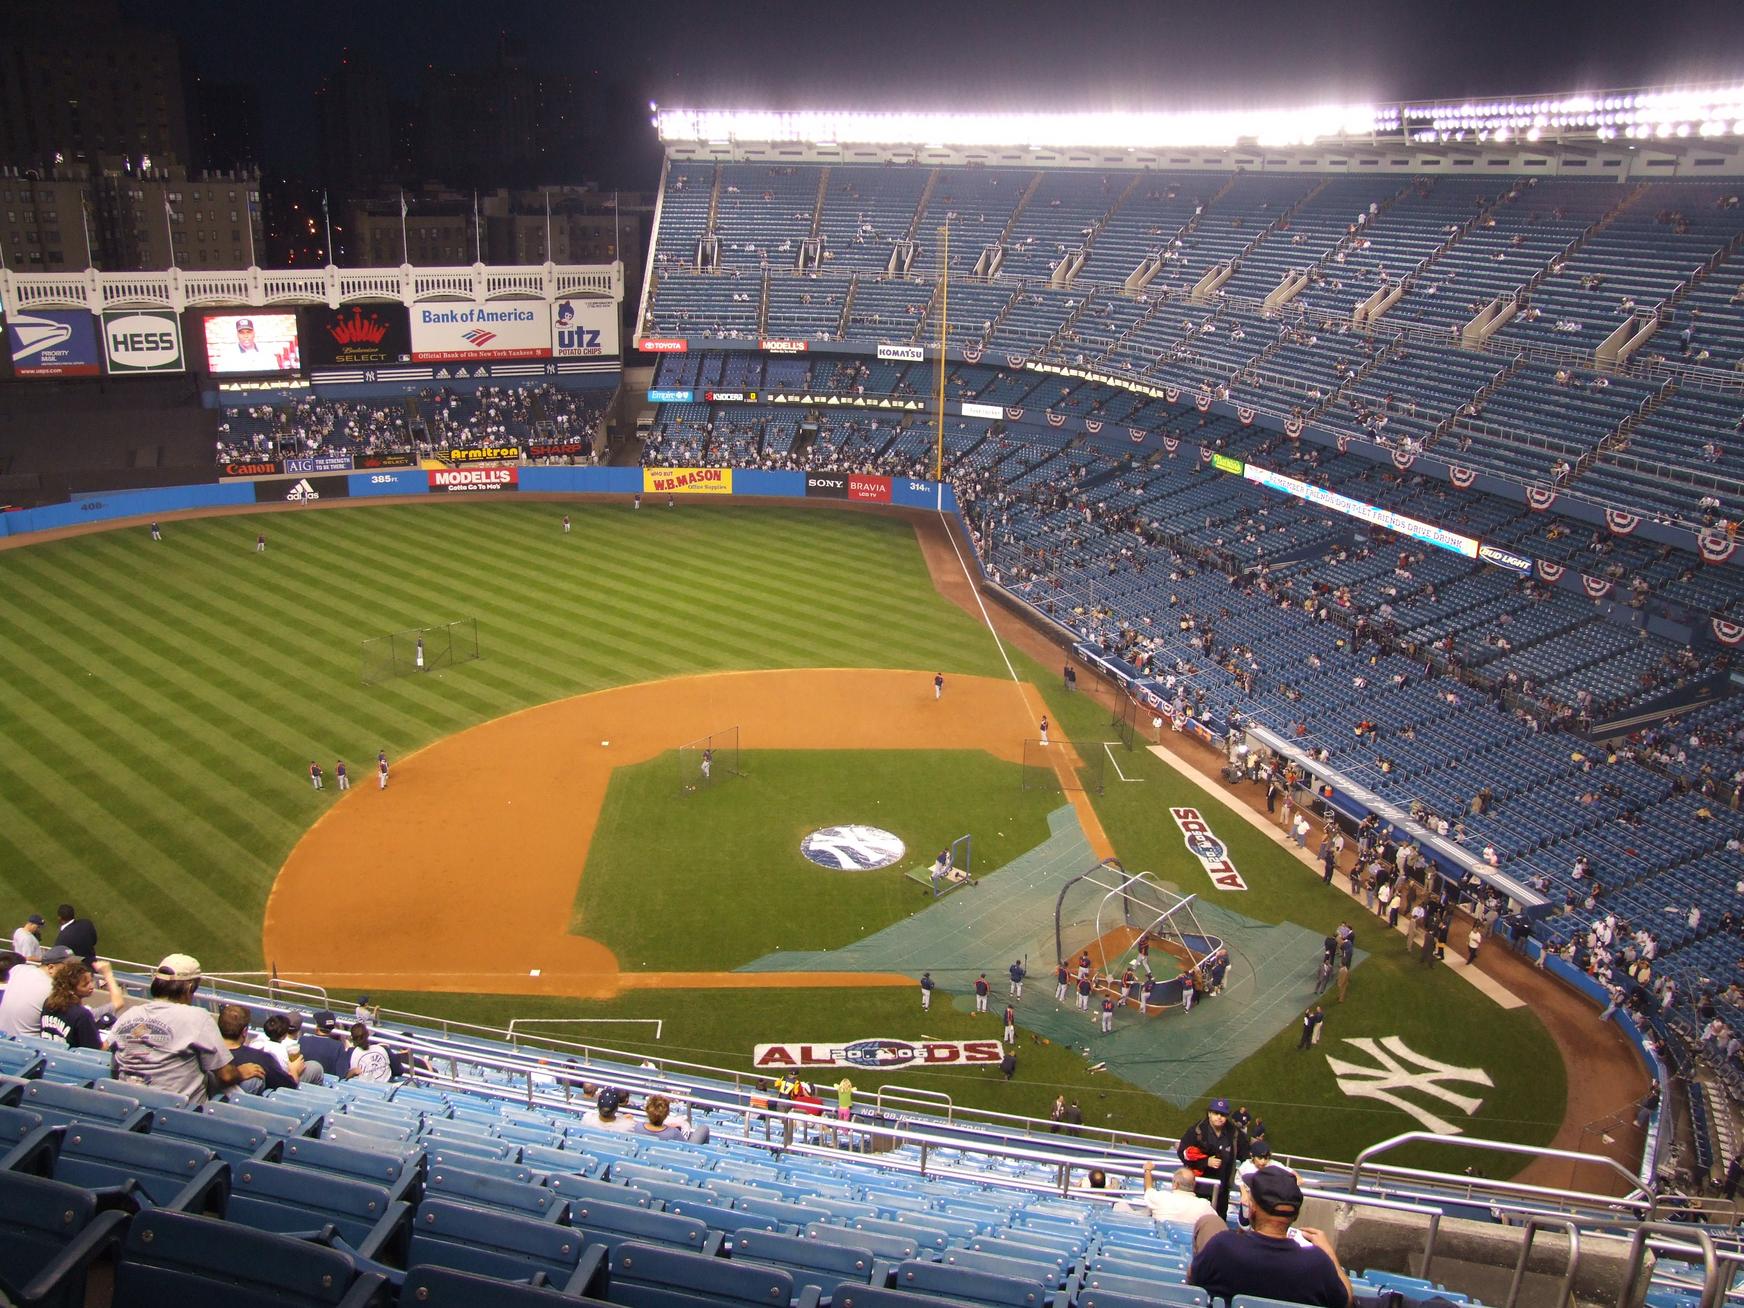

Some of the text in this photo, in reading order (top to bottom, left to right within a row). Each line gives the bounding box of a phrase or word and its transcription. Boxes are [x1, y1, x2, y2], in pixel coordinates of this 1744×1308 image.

[422, 308, 534, 324] Bank of America
[112, 332, 174, 353] HESS
[558, 326, 601, 348] utz
[558, 347, 602, 356] POTATO CHIPS
[762, 341, 805, 350] MODELL'S
[336, 353, 387, 363] SELECT
[418, 352, 441, 360] Official
[508, 349, 533, 357] Yankees
[879, 348, 922, 358] KOMATSU
[713, 393, 744, 401] KYOCERA
[451, 447, 518, 460] Armitron
[531, 444, 582, 455] SHARP
[226, 463, 276, 475] Canon
[289, 460, 312, 472] AIG
[435, 470, 511, 485] MODELL'S
[808, 479, 843, 488] SONY
[850, 482, 886, 493] BRAVIA
[1305, 487, 1335, 504] FRIENDS
[1358, 506, 1373, 518] LET
[1373, 511, 1406, 529] FRIENDS
[1407, 524, 1432, 538] DRIVE
[1433, 532, 1463, 548] DRUNK
[1481, 547, 1532, 570] BUD LIGHT
[756, 1042, 1001, 1066] AL 20 06 DS
[780, 1080, 794, 1095] 17
[861, 1107, 875, 1116] NO
